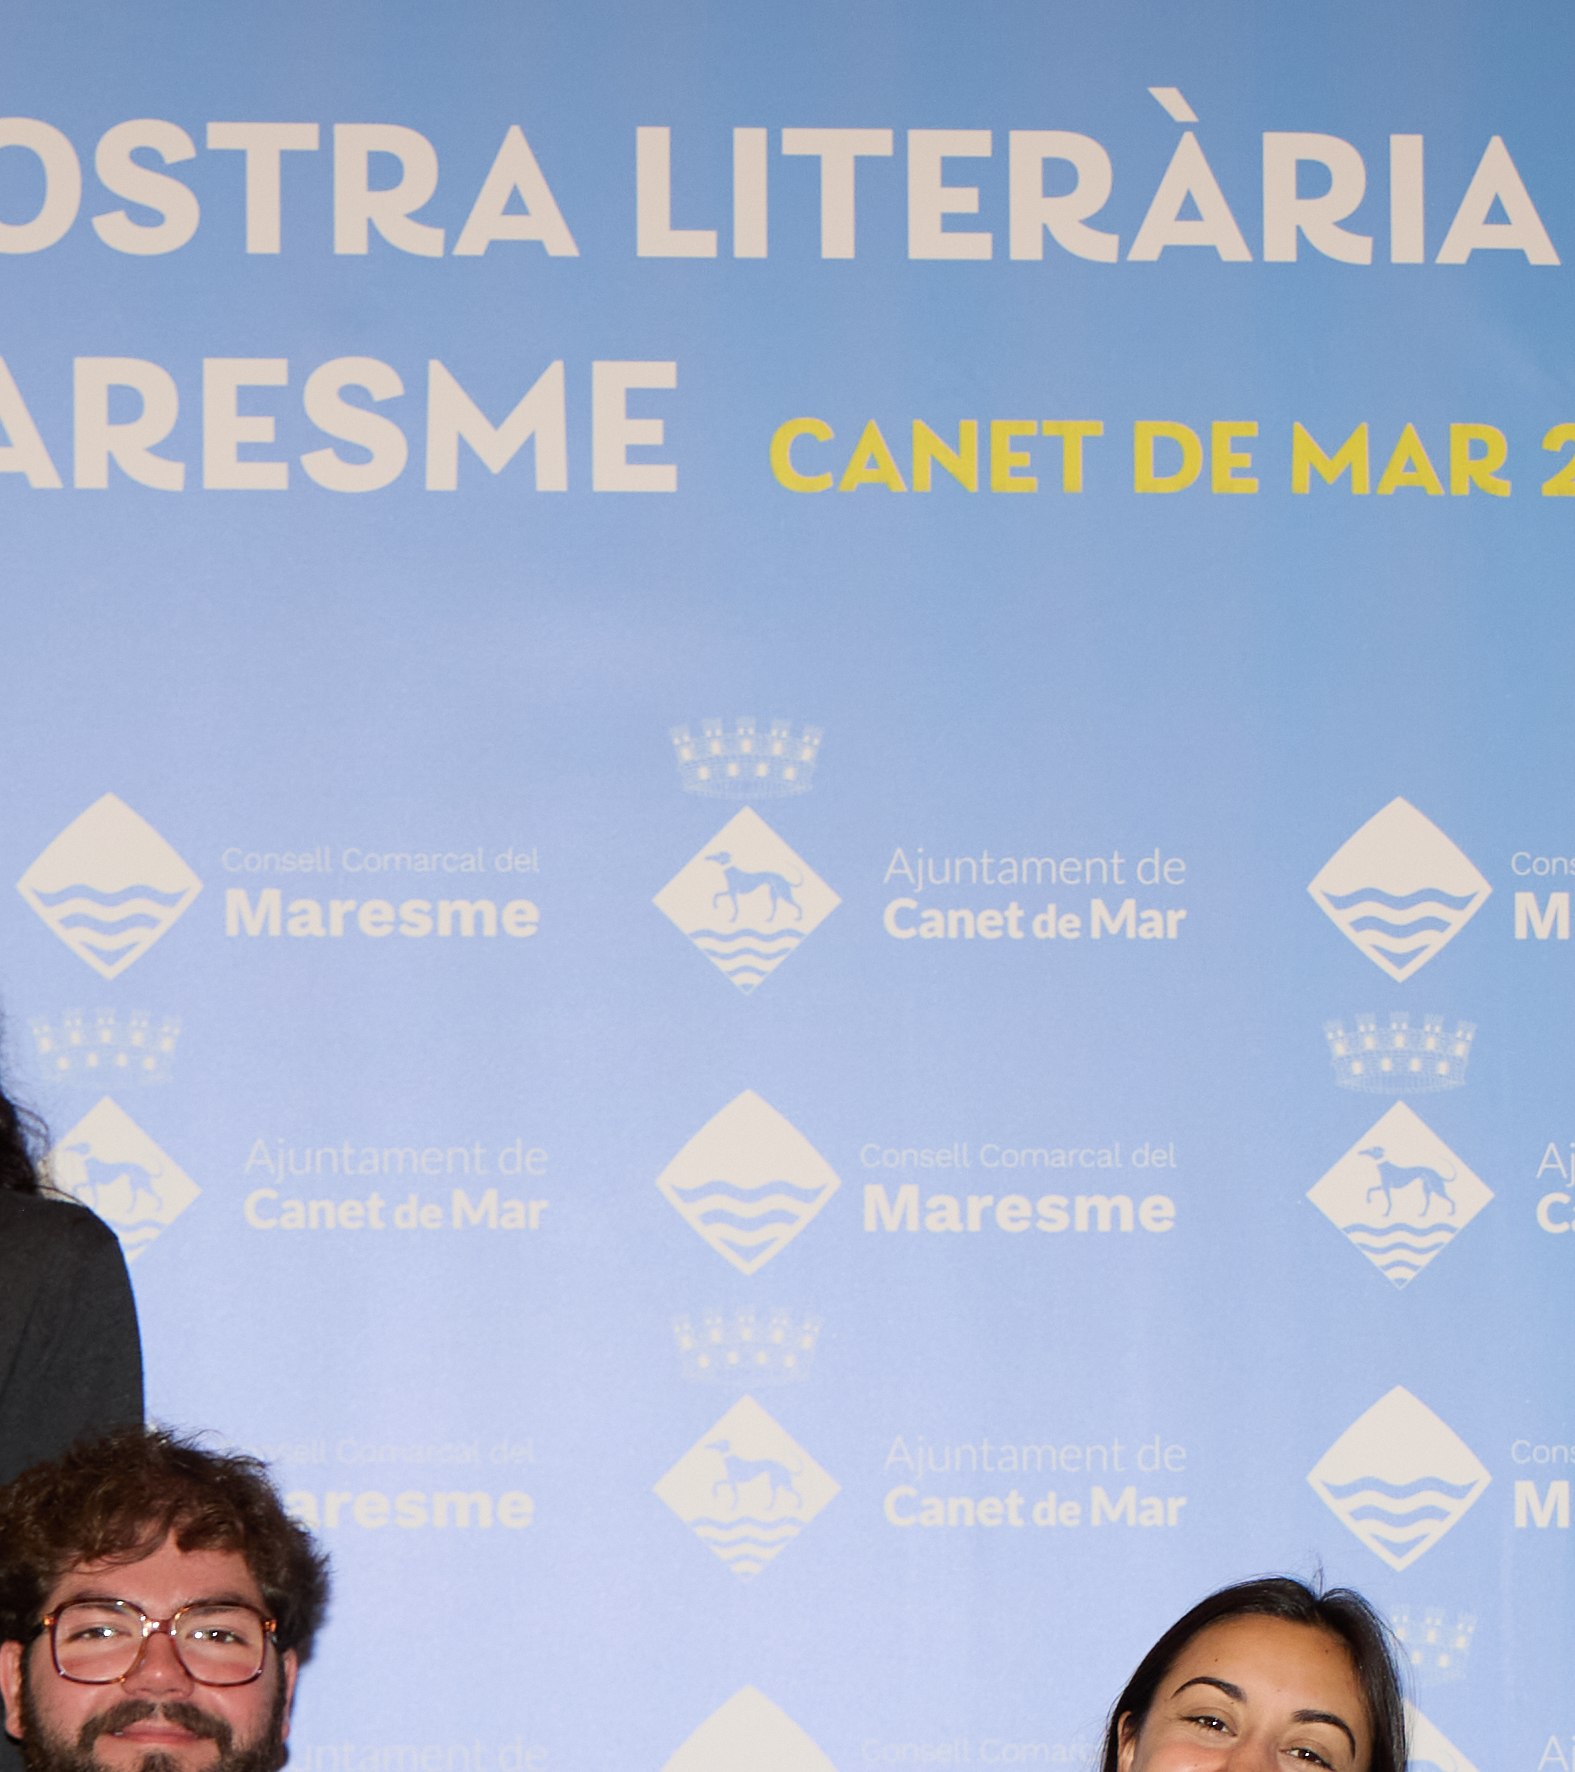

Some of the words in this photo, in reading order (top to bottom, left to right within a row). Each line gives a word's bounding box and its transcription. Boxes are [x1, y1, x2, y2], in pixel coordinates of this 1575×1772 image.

[637, 87, 1561, 265] LITERÀRIA
[770, 418, 1102, 492] CANET
[1134, 421, 1257, 493] DE
[1292, 423, 1510, 496] MAR
[221, 846, 332, 872] Consell
[342, 847, 485, 872] Comarcal
[495, 847, 539, 873] del
[884, 848, 1125, 890] Ajuntament
[1137, 848, 1186, 885] de
[227, 889, 539, 937] Maresme
[884, 898, 1024, 939] Canet
[1033, 904, 1081, 938] de
[1092, 899, 1187, 938] Mar
[245, 1138, 487, 1180] Ajuntament
[498, 1138, 548, 1175] de
[860, 1143, 970, 1168] Consell
[980, 1142, 1122, 1168] Comarcal
[1131, 1142, 1177, 1168] del
[244, 1188, 385, 1229] Canet
[394, 1195, 442, 1229] de
[453, 1189, 548, 1229] Mar
[866, 1185, 1175, 1232] Maresme
[884, 1435, 1125, 1476] Ajuntament
[1136, 1435, 1186, 1473] de
[283, 1490, 534, 1530] aresme
[884, 1486, 1024, 1527] Canet
[1033, 1492, 1081, 1526] de
[1092, 1487, 1187, 1526] Mar
[498, 1735, 547, 1772] de
